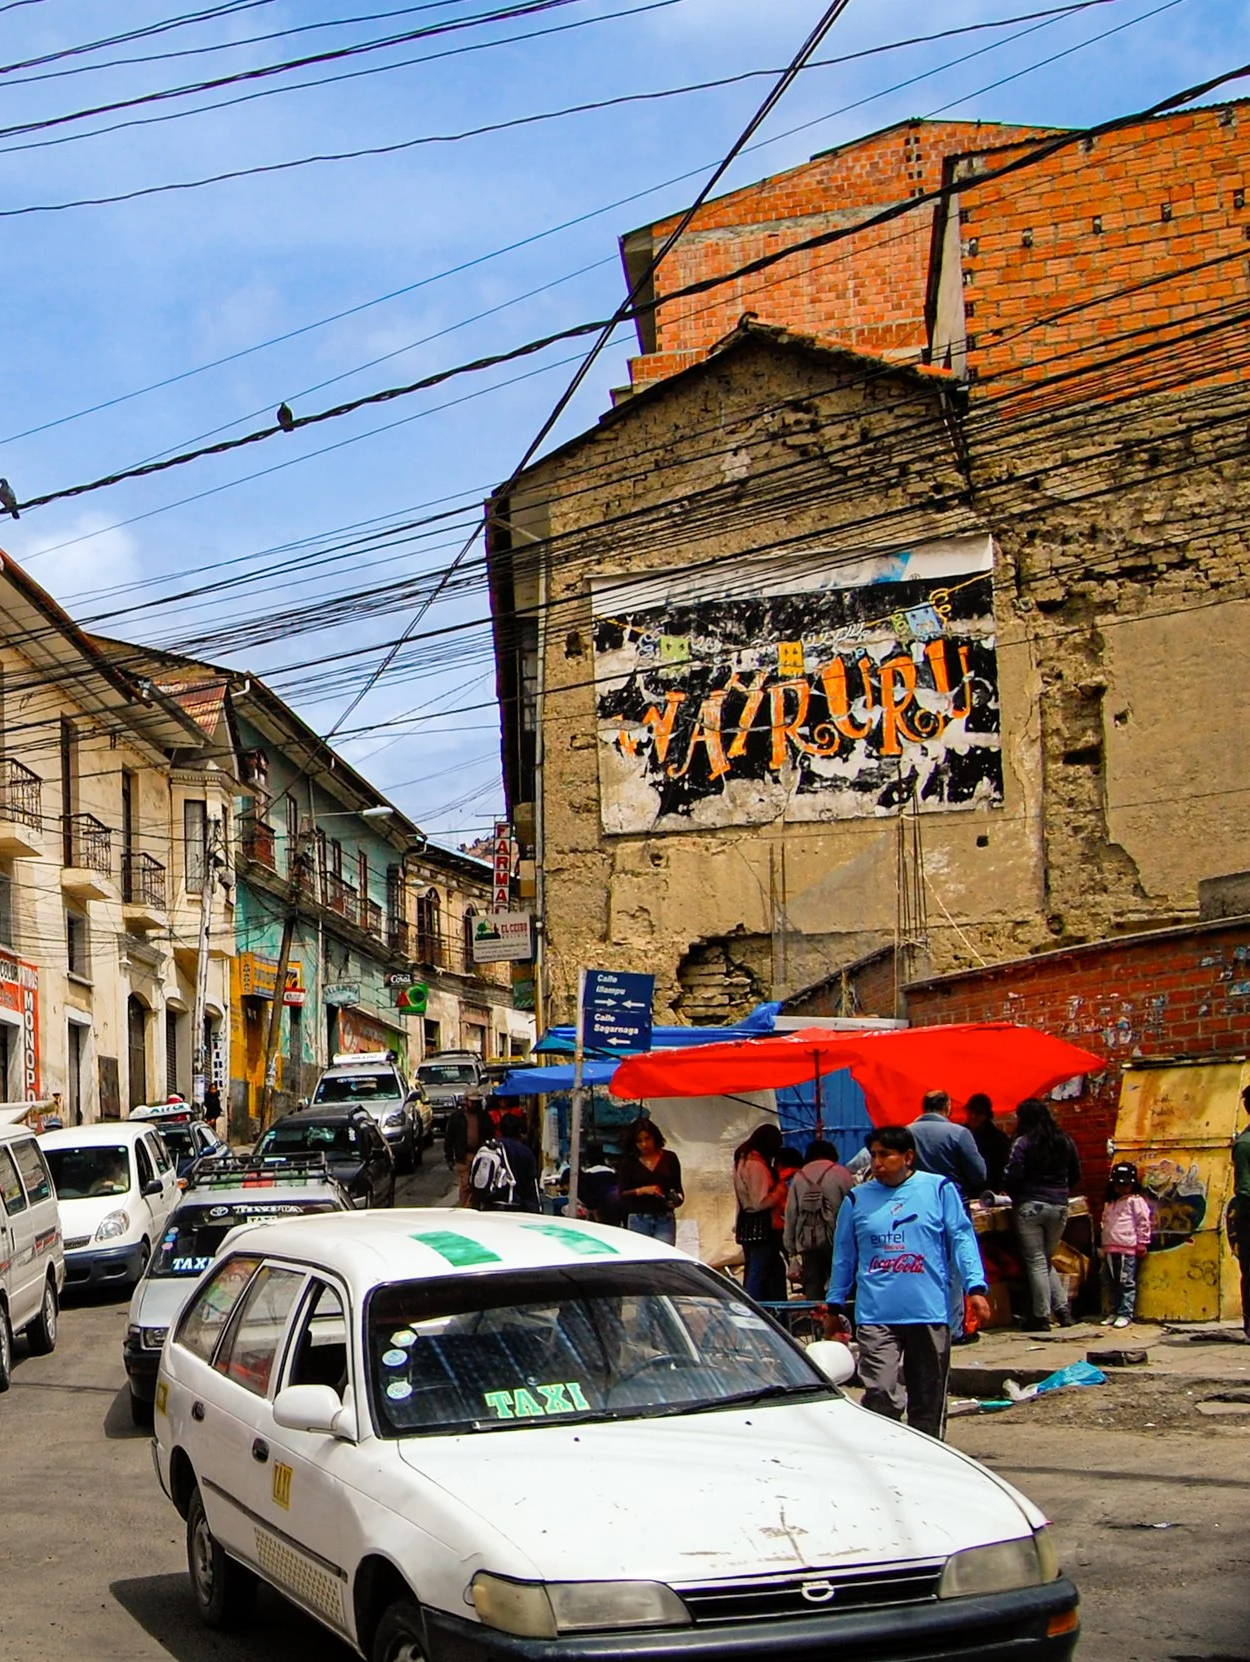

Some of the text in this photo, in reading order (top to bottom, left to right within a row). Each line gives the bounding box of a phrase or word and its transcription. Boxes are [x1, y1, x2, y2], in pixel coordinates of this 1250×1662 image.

[594, 1013, 616, 1022] Calle
[593, 1024, 639, 1035] Sagarnaga
[870, 1230, 905, 1245] entel
[484, 1382, 591, 1419] TAXI
